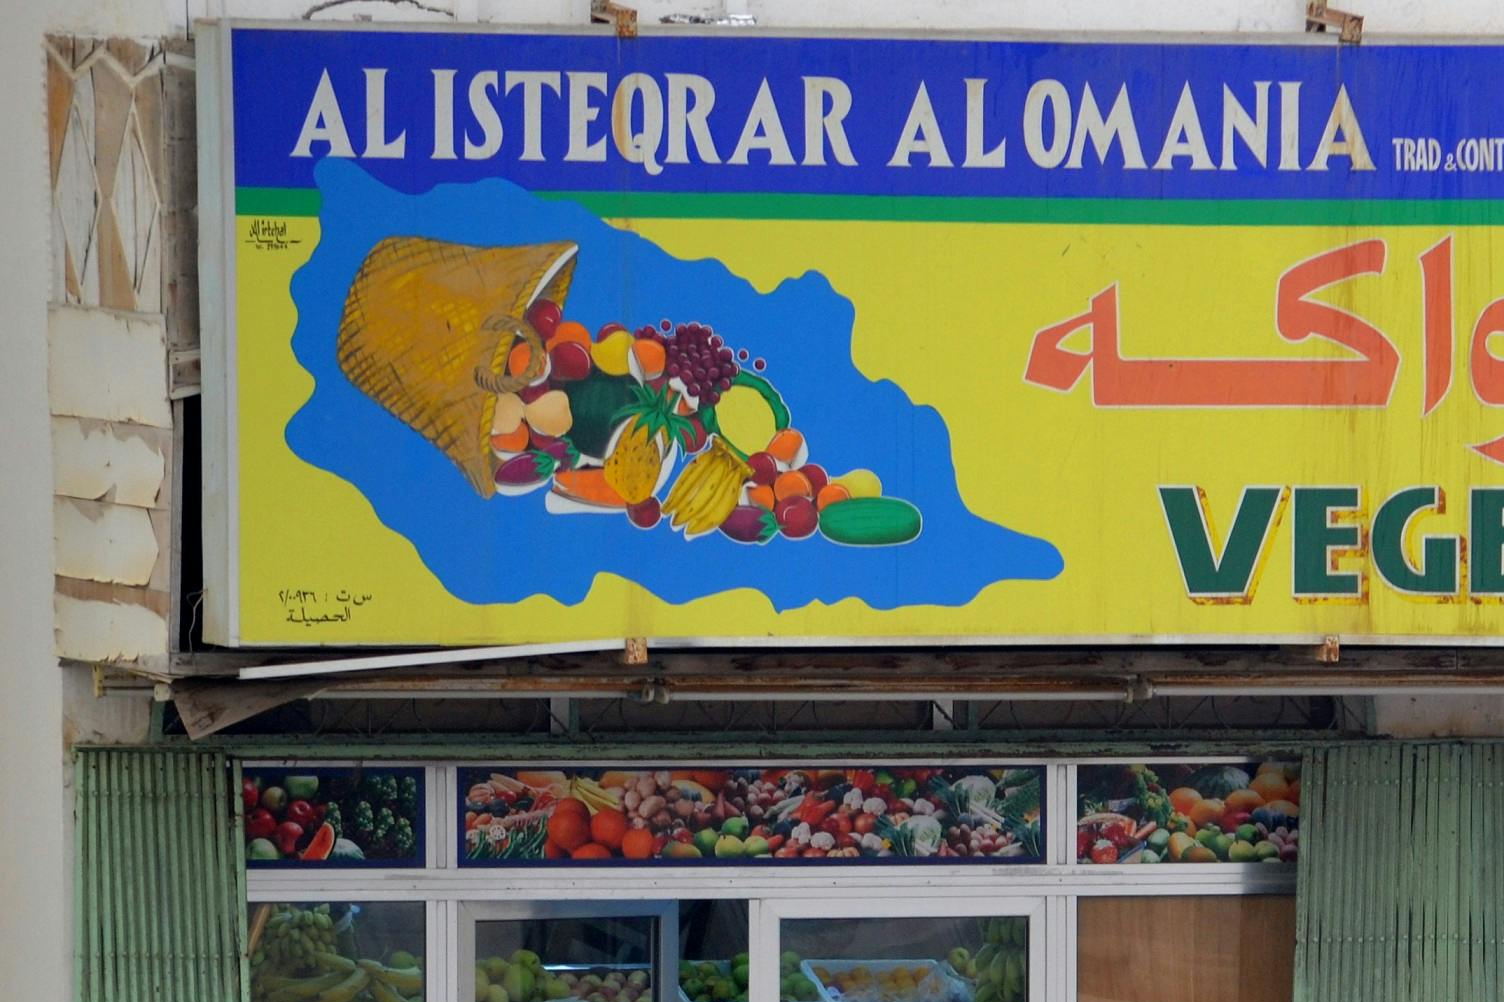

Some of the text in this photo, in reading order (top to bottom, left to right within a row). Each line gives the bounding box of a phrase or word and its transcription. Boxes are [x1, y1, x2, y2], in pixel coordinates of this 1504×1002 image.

[290, 68, 406, 159] AL
[431, 69, 859, 176] ISTEQRAR
[886, 78, 1006, 169] AL
[1022, 78, 1377, 171] OMANIA
[1391, 137, 1442, 172] TRAD
